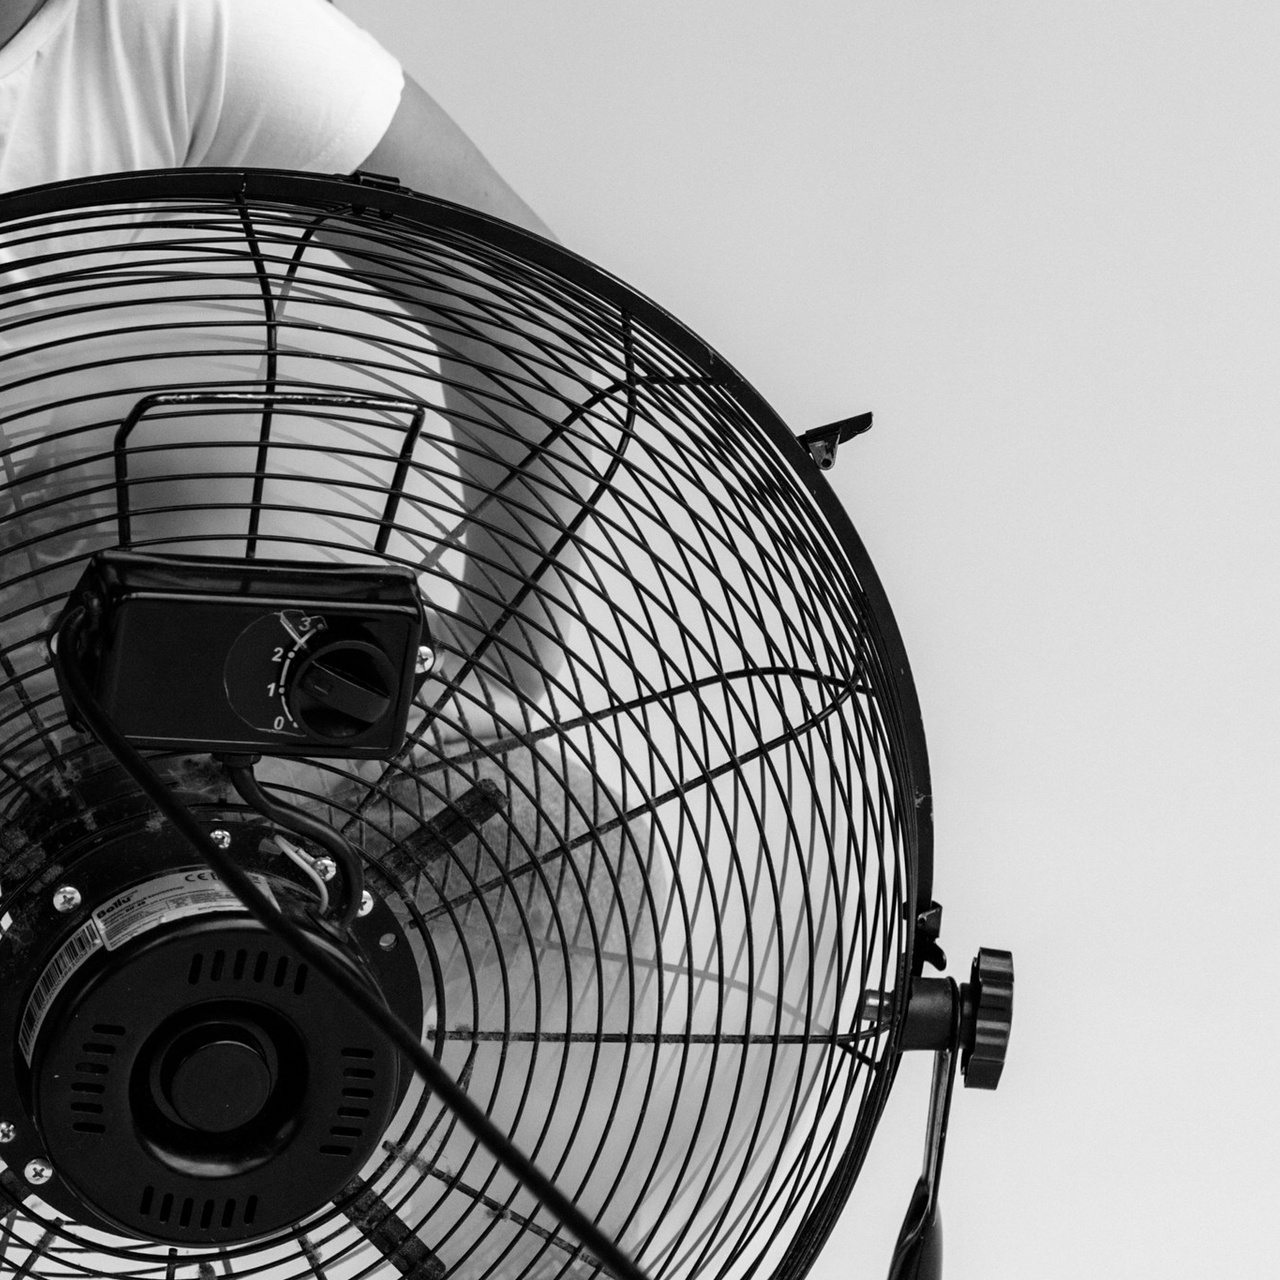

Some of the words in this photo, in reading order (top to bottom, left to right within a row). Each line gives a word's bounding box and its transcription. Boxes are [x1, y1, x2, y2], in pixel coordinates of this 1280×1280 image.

[298, 616, 312, 631] 3
[271, 646, 284, 662] 2
[266, 682, 276, 697] 1
[273, 715, 285, 730] 0
